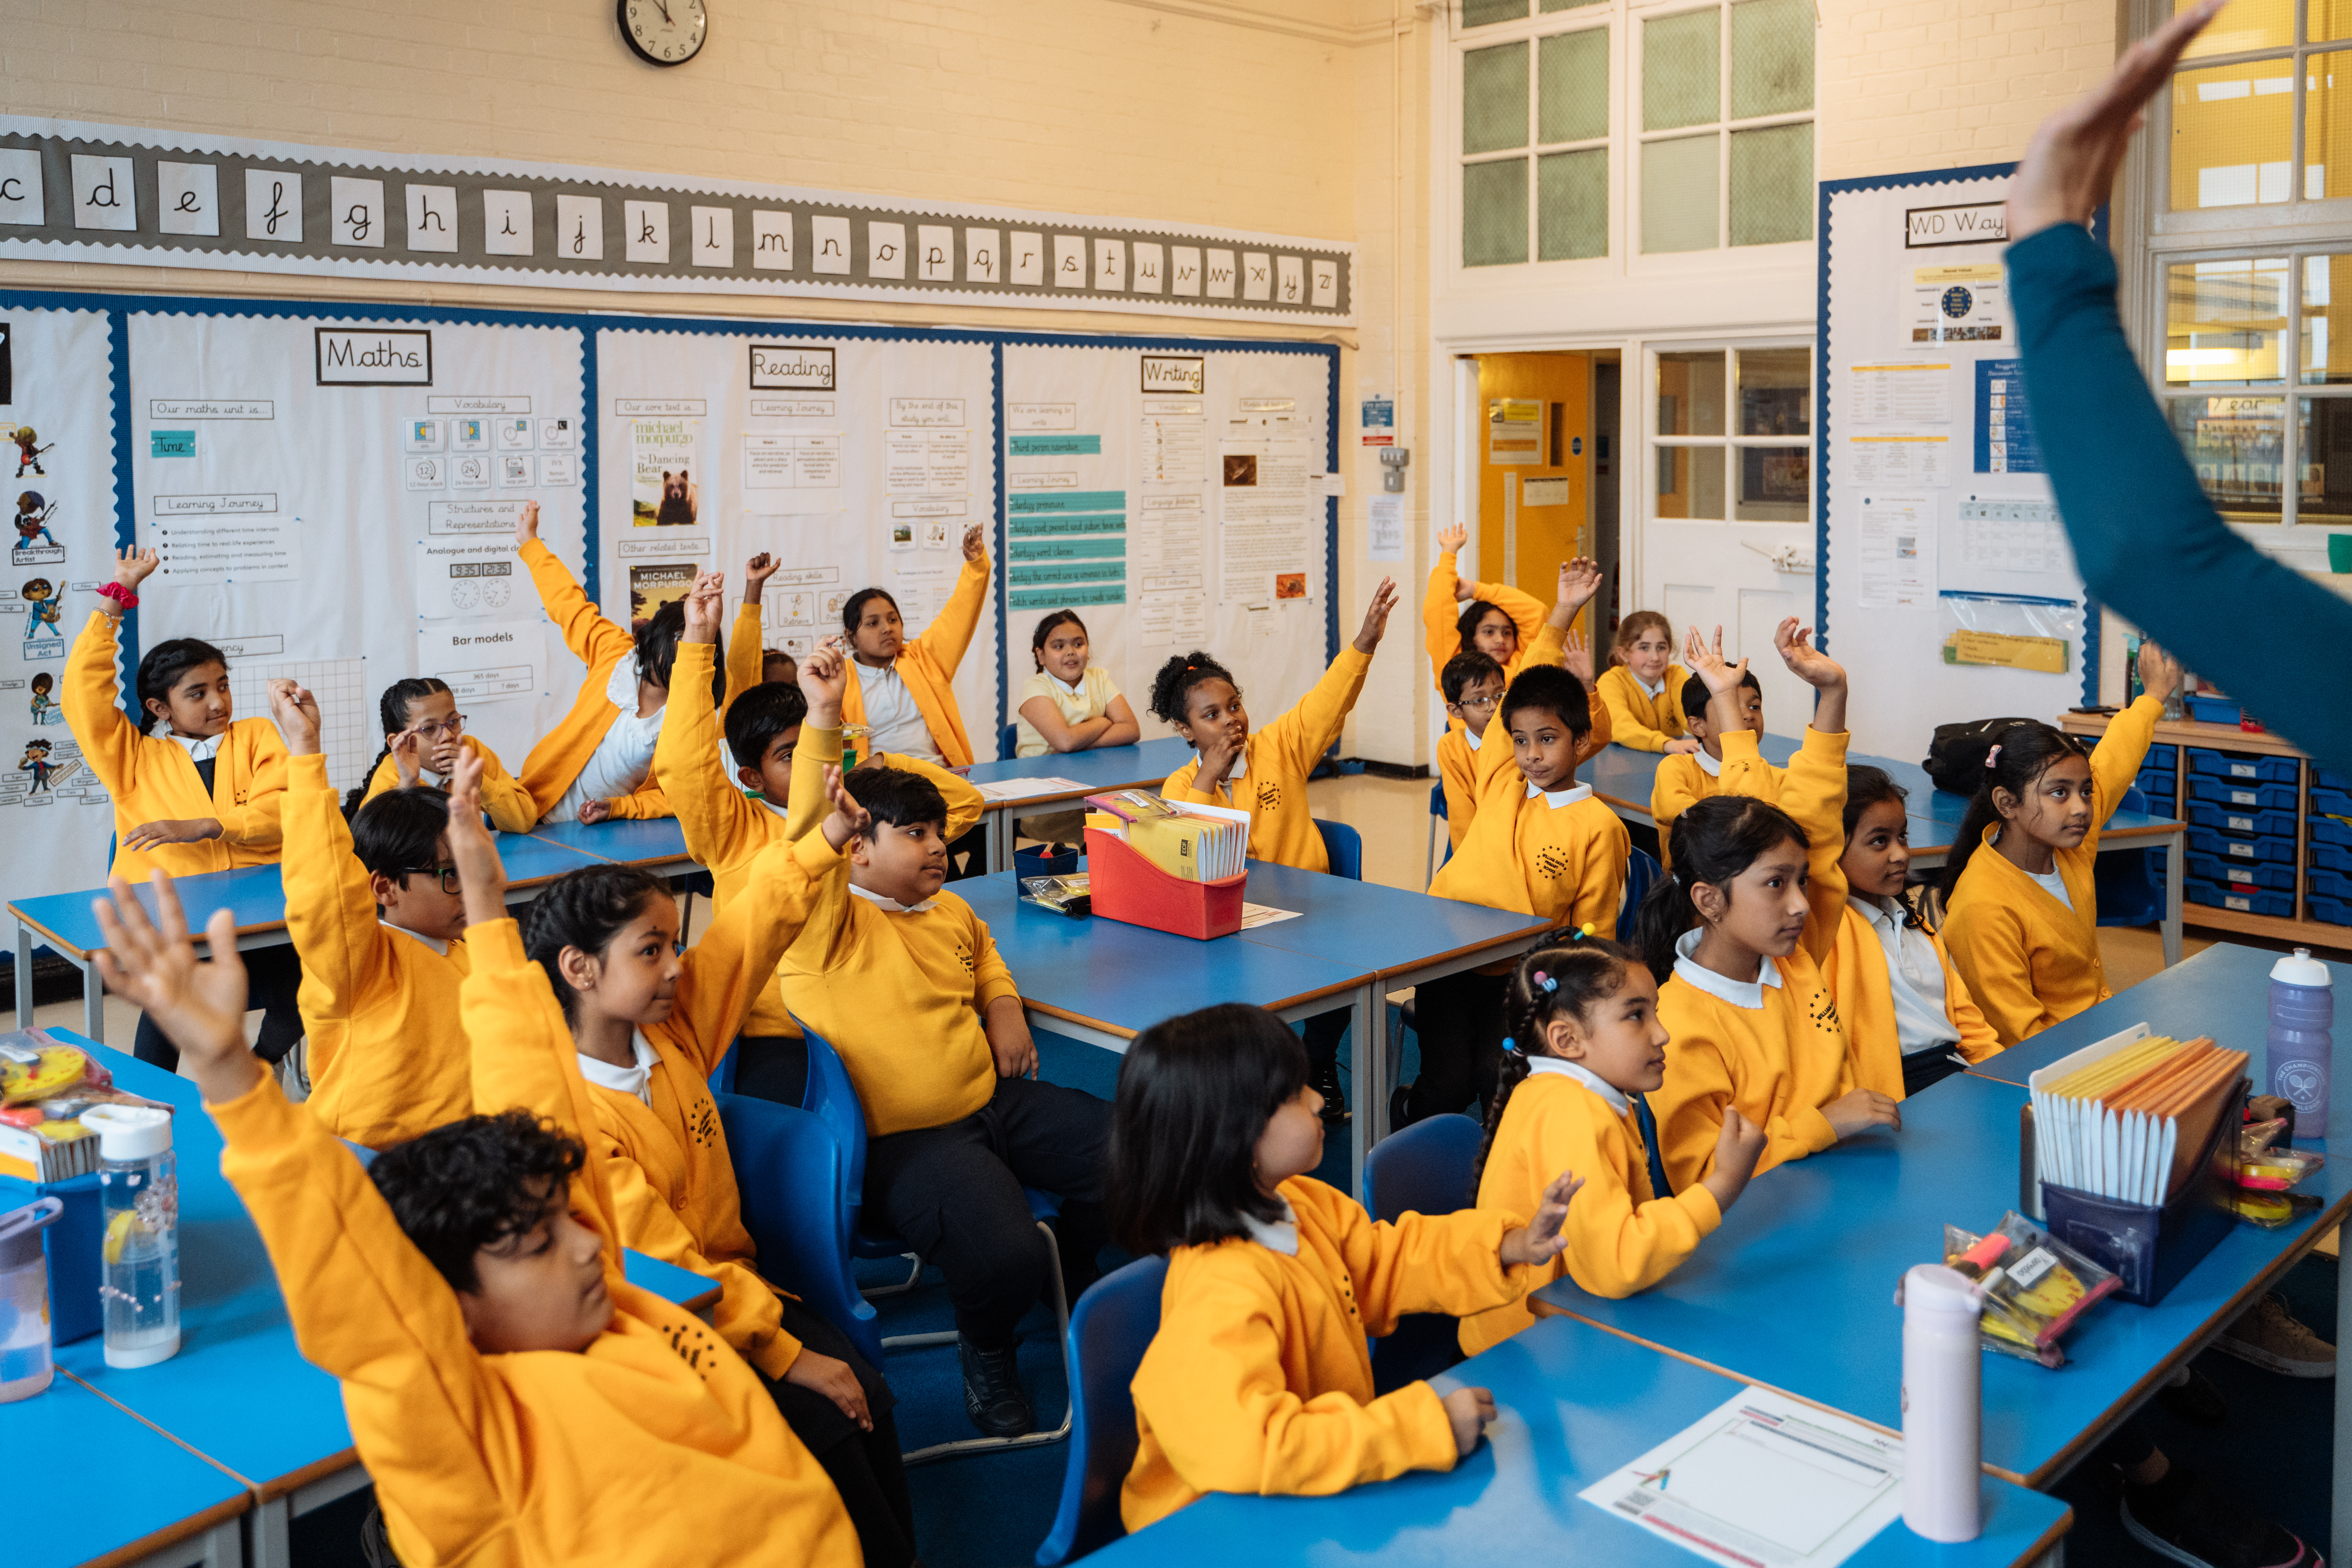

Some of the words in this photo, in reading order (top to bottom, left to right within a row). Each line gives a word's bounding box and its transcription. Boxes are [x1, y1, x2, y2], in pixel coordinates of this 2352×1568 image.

[629, 6, 637, 18] 9
[635, 25, 642, 37] 8
[690, 32, 696, 43] 4
[649, 40, 656, 53] 7
[679, 44, 686, 56] 5
[664, 47, 671, 59] 6
[1910, 215, 1945, 235] WD
[1954, 212, 2004, 237] Way
[0, 175, 25, 201] c
[86, 167, 120, 208] d
[174, 190, 201, 213] e
[264, 180, 289, 234] f
[344, 203, 372, 241] g
[418, 194, 446, 233] h
[500, 210, 517, 235] i
[571, 213, 587, 254] j
[638, 210, 658, 245] k
[702, 216, 721, 248] l
[758, 228, 788, 253] m
[821, 234, 842, 257] n
[875, 242, 898, 261] o
[925, 244, 946, 270] p
[973, 248, 994, 276] q
[1018, 249, 1034, 269] r
[1061, 252, 1078, 272] s
[1104, 249, 1116, 278] t
[1140, 258, 1158, 278] u
[1176, 263, 1198, 279] v
[1209, 264, 1234, 283] w
[1251, 266, 1268, 282] x
[1284, 273, 1297, 300] y
[1317, 272, 1333, 289] z
[326, 338, 423, 369] Maths
[753, 350, 832, 389] Reading
[1146, 363, 1200, 388] Writing
[157, 403, 178, 413] Our
[185, 404, 219, 414] maths
[224, 405, 244, 413] unit
[454, 399, 506, 412] Vocabulary
[625, 402, 640, 411] Our
[761, 403, 793, 414] Learning
[796, 403, 824, 415] Journey
[897, 401, 906, 411] By
[937, 402, 943, 411] of
[1039, 407, 1062, 416] learning
[901, 415, 920, 425] study
[922, 417, 934, 425] you
[636, 421, 683, 434] michael
[155, 437, 186, 452] Time
[636, 434, 693, 447] morpurgo
[1013, 440, 1029, 452] Third
[1031, 444, 1049, 455] person
[1052, 440, 1078, 451] narrative
[649, 454, 690, 466] Dancing
[637, 463, 662, 473] Bear
[1018, 475, 1044, 486] Learning
[1047, 475, 1070, 485] Journey
[168, 498, 215, 511] Learning
[220, 497, 263, 511] Journey
[447, 505, 493, 513] Structures
[498, 504, 514, 513] and
[913, 505, 949, 514] Vocabulary
[1148, 499, 1173, 508] Language
[446, 519, 516, 532] Representations
[15, 548, 62, 556] Breakthrough
[427, 547, 465, 555] Analogue
[485, 544, 509, 553] digital
[623, 543, 646, 553] Other
[650, 543, 676, 551] related
[641, 572, 686, 581] MICHAEL
[773, 574, 802, 583] Reading
[634, 580, 692, 590] MORPURGO
[452, 636, 472, 646] Bar
[475, 632, 513, 644] models
[26, 641, 61, 650] Unsigned
[1543, 865, 1556, 874] SCHOOL
